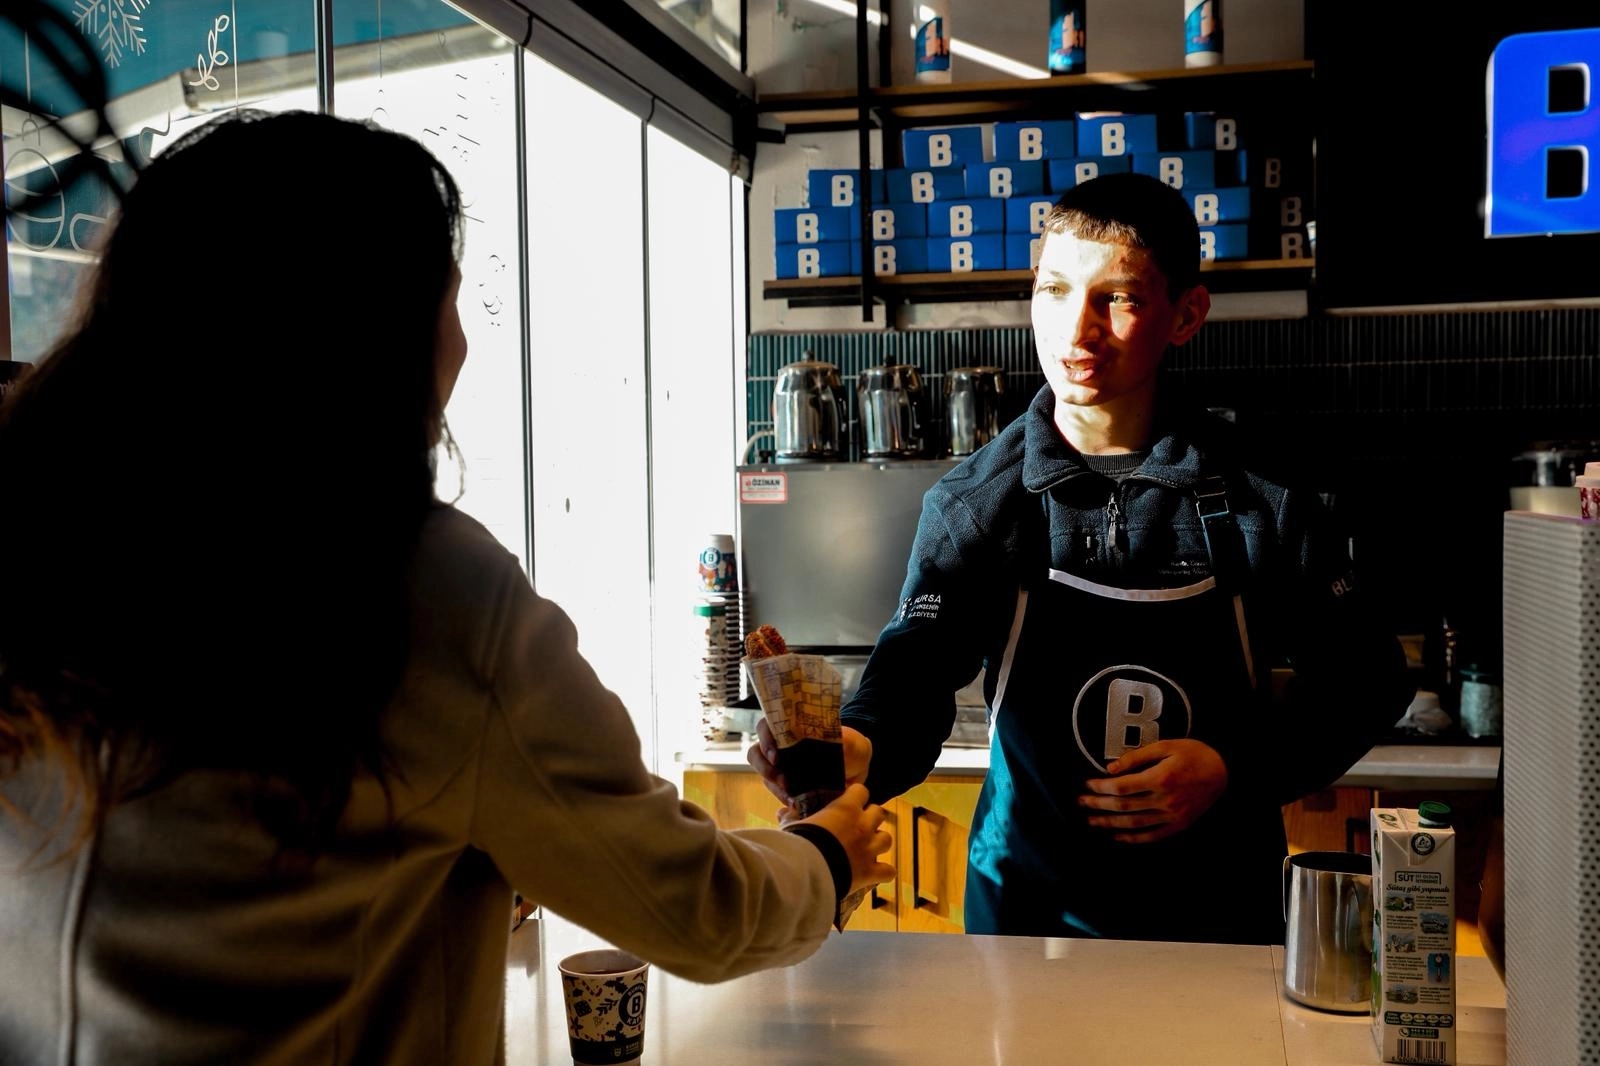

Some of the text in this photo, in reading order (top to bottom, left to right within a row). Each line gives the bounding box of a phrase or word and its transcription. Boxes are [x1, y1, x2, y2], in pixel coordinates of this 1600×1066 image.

[1020, 127, 1043, 161] B
[1102, 122, 1126, 157] B
[1215, 118, 1237, 151] B
[1484, 26, 1600, 240] B
[929, 134, 953, 168] B
[911, 171, 935, 203] B
[989, 167, 1013, 198] B
[1159, 157, 1184, 190] B
[1264, 157, 1282, 188] B
[832, 174, 854, 207] B
[873, 209, 895, 240] B
[950, 205, 973, 237] B
[1029, 202, 1053, 234] B
[1194, 193, 1219, 226] B
[1280, 196, 1303, 227] B
[796, 213, 819, 244] B
[797, 248, 821, 278] B
[874, 245, 898, 276] B
[950, 241, 974, 273] B
[1104, 678, 1164, 760] B
[1398, 873, 1414, 882] SÜT
[632, 996, 640, 1014] B
